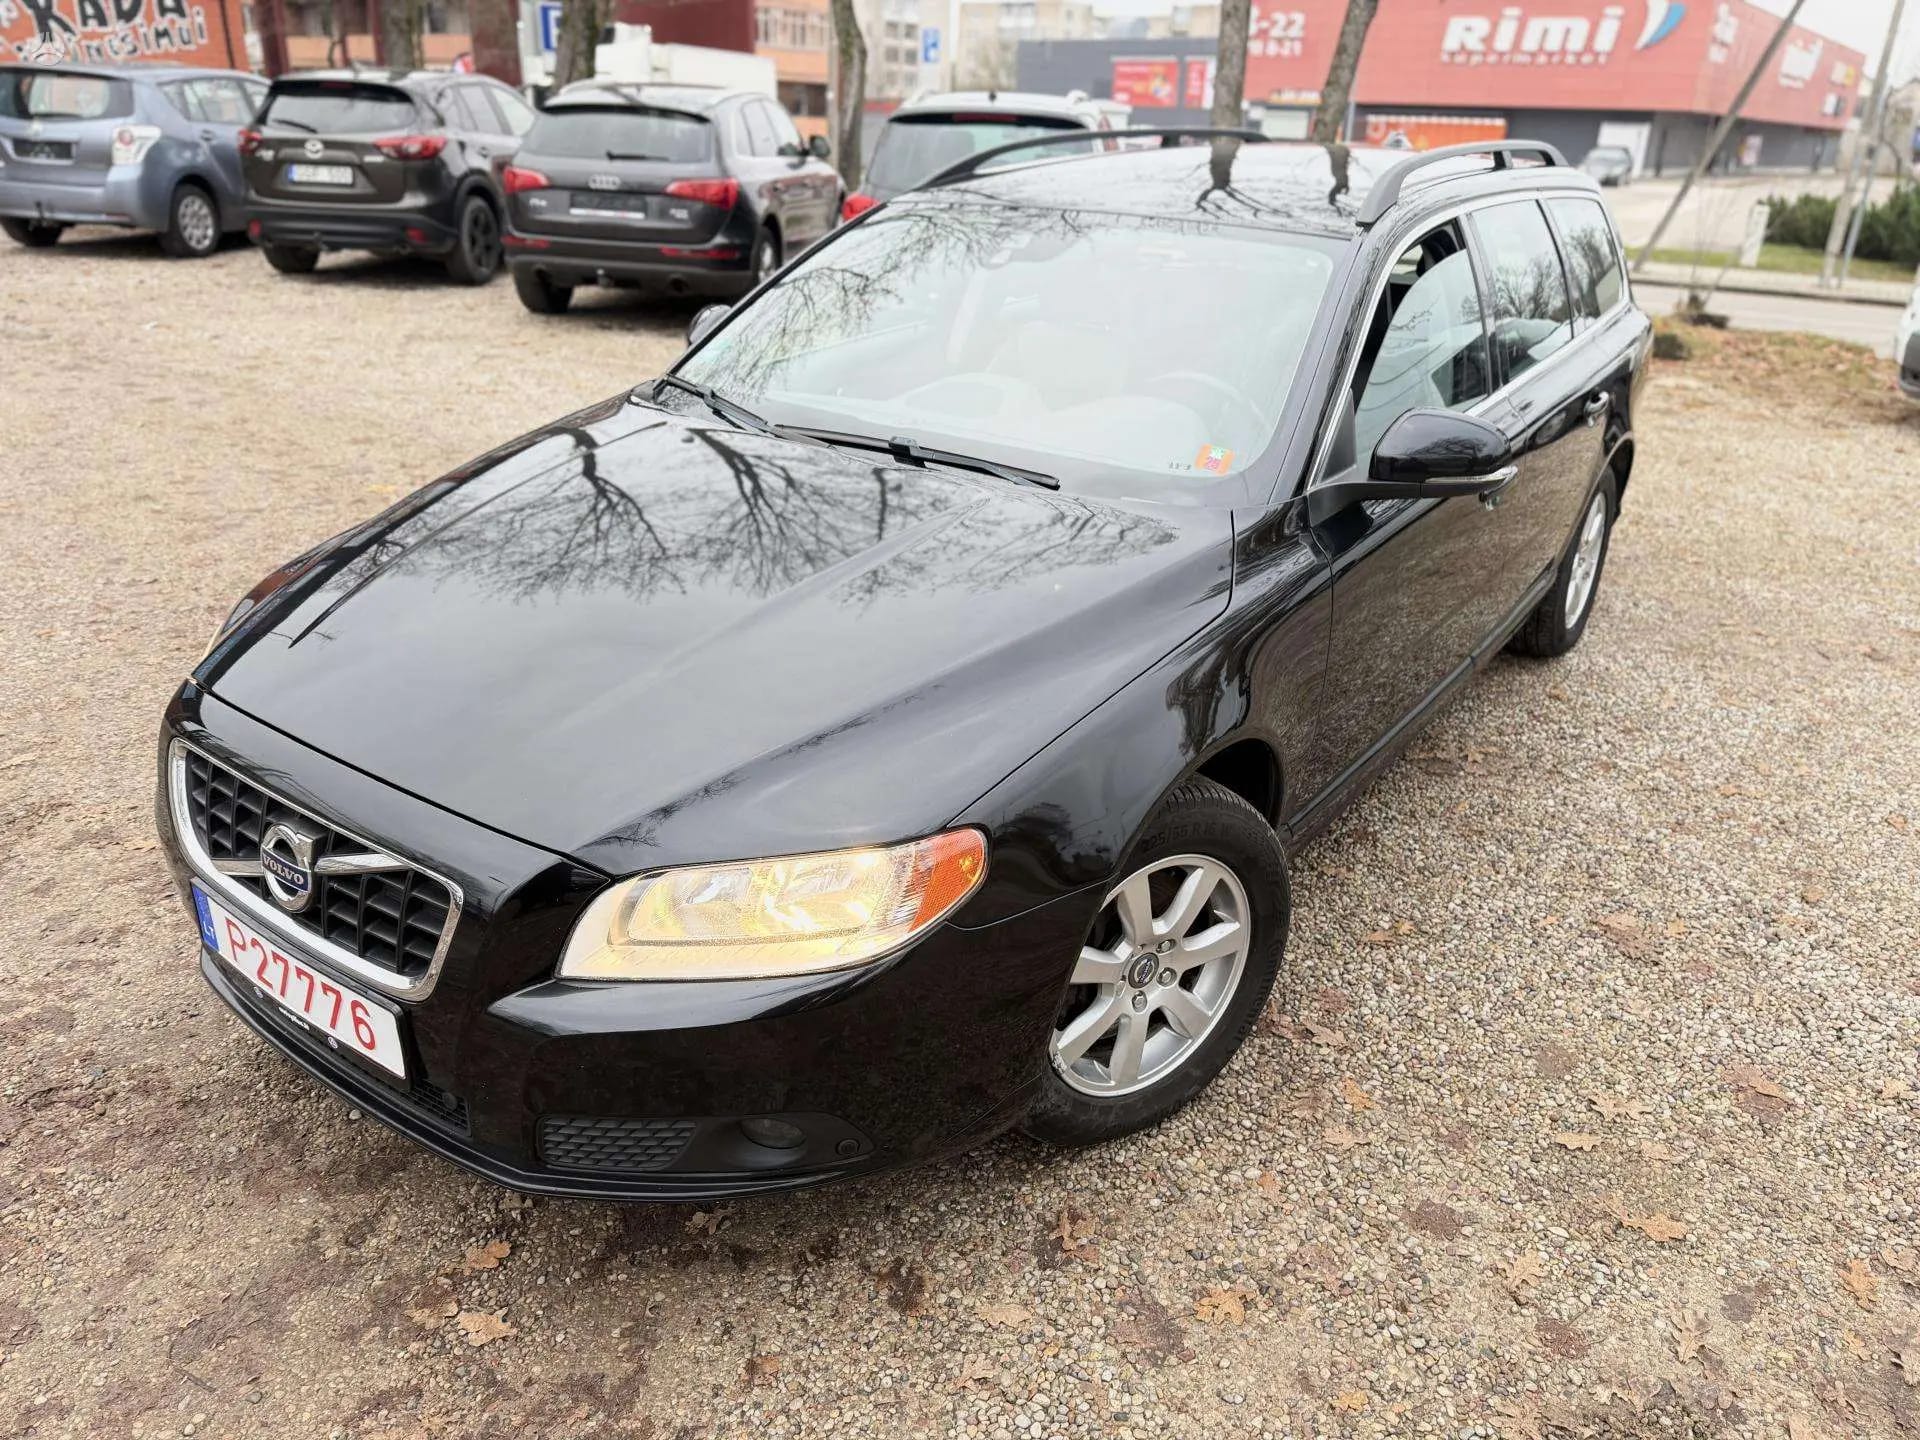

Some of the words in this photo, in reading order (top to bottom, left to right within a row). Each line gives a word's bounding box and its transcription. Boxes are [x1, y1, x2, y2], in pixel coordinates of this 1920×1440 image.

[1441, 6, 1625, 53] Rimi
[262, 852, 305, 885] VOLVO
[224, 915, 376, 1051] P27776
